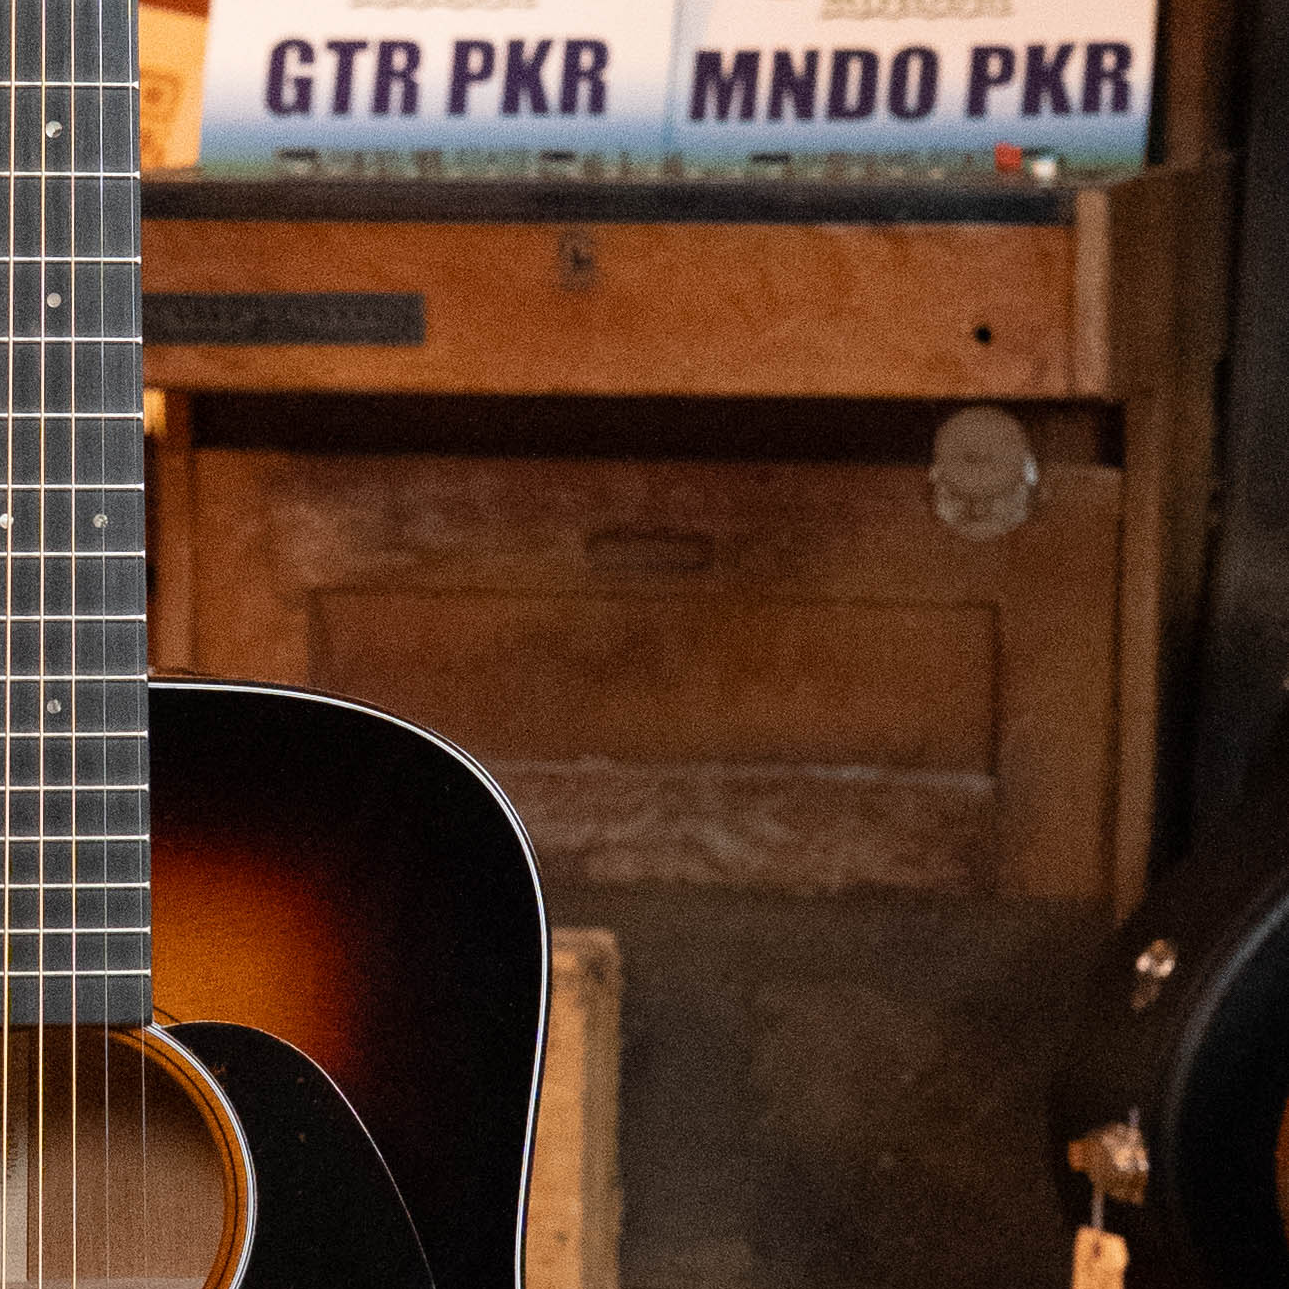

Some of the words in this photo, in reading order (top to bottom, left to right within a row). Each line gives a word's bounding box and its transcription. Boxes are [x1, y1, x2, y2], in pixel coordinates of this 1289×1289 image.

[264, 38, 423, 117] GTR
[447, 38, 611, 118] PKR
[688, 45, 940, 124] MNDO
[966, 41, 1134, 120] PKR
